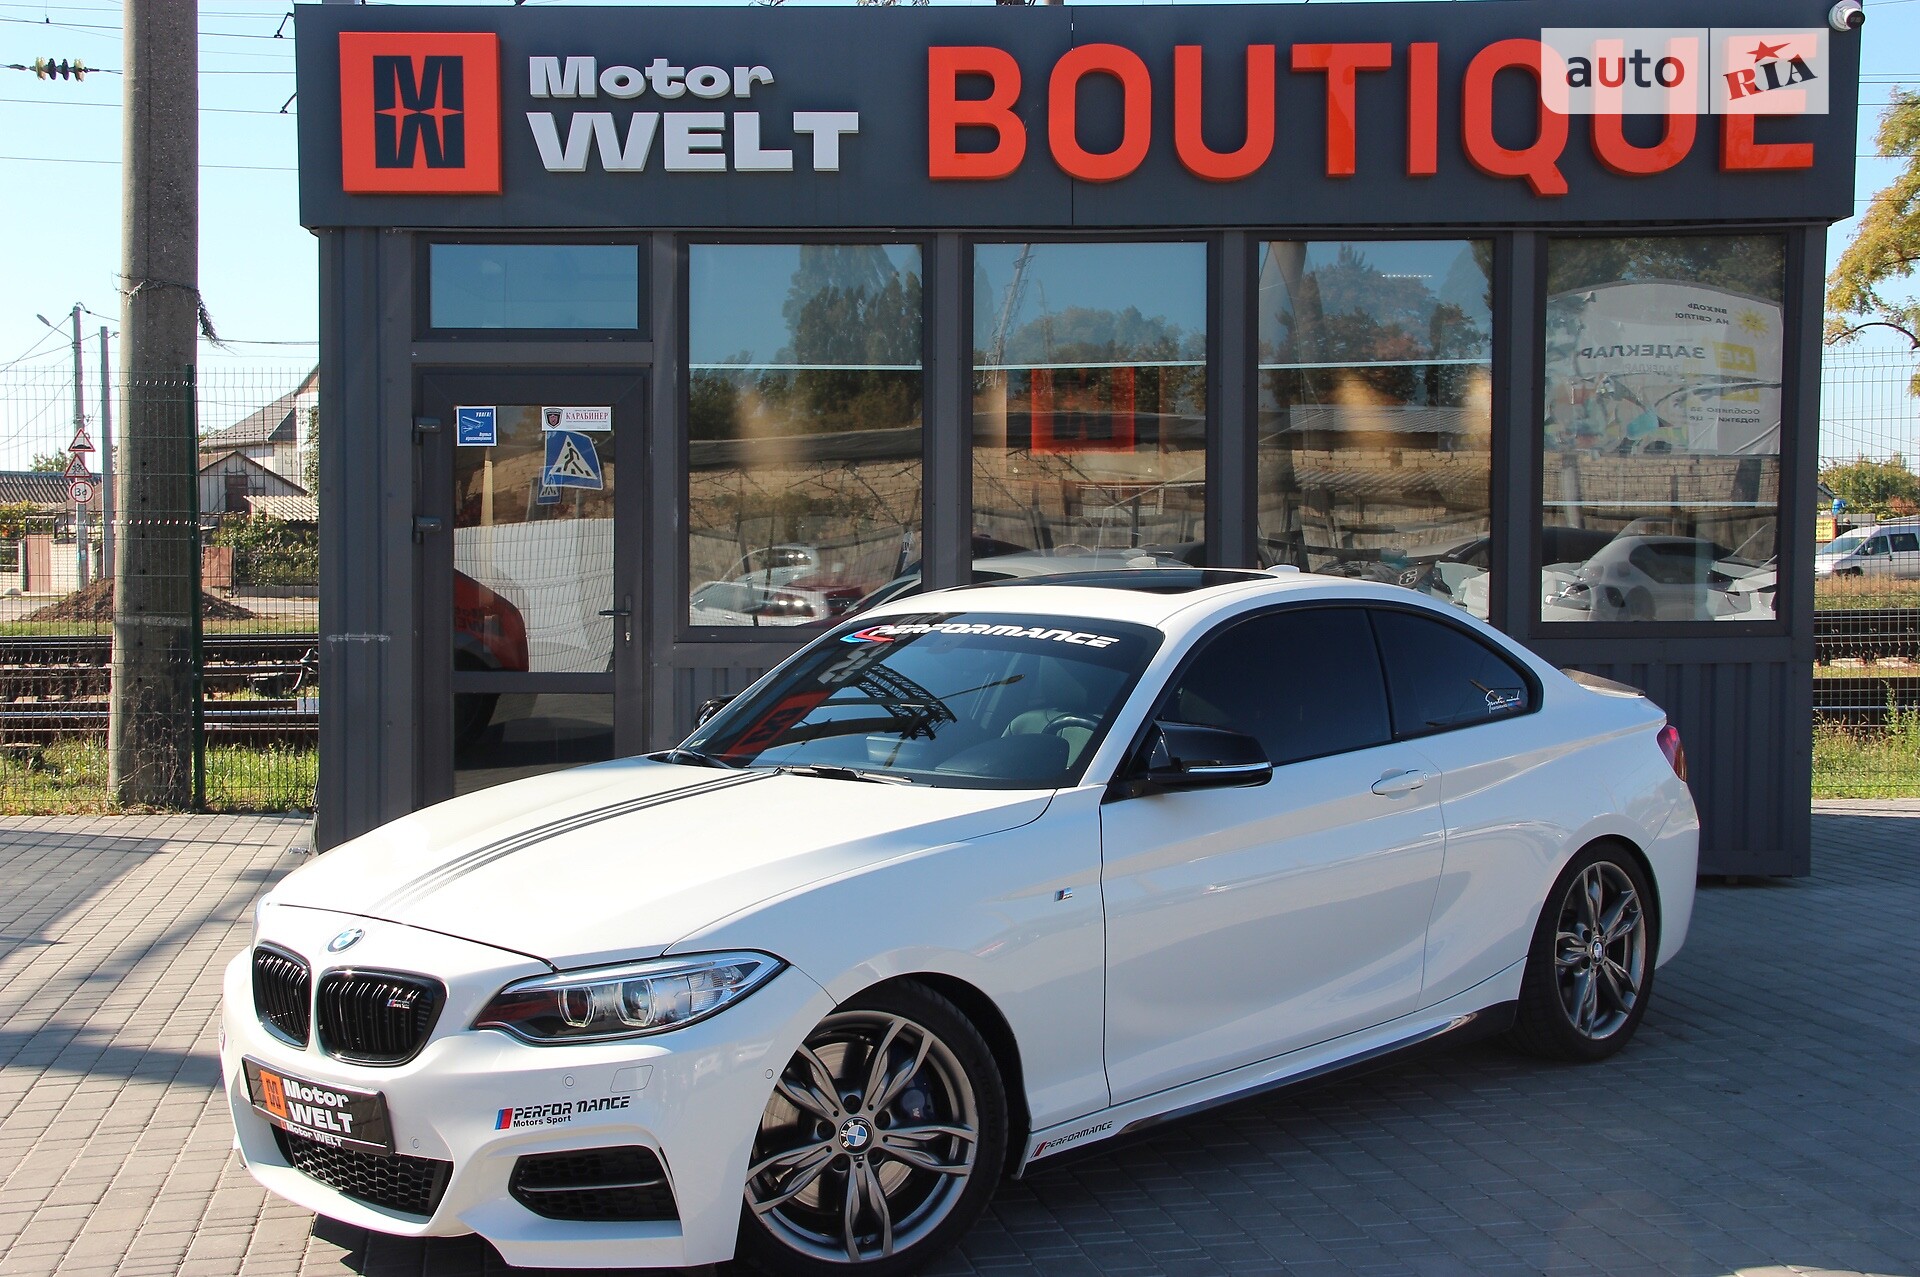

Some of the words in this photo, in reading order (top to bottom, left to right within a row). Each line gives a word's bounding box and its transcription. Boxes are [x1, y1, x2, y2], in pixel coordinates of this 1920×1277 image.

[529, 56, 775, 99] Motor
[928, 34, 1817, 196] BOUTIQUE
[526, 111, 859, 172] WELT
[565, 411, 609, 420] КАРАБИНЕР
[870, 622, 1120, 649] PERFORMANCE
[282, 1078, 349, 1108] Motor
[287, 1101, 353, 1134] WELT
[513, 1118, 543, 1128] Motors
[546, 1115, 571, 1125] Sport
[287, 1123, 313, 1139] Motor
[314, 1131, 343, 1147] WELT
[1044, 1120, 1113, 1149] PERFORMANCE
